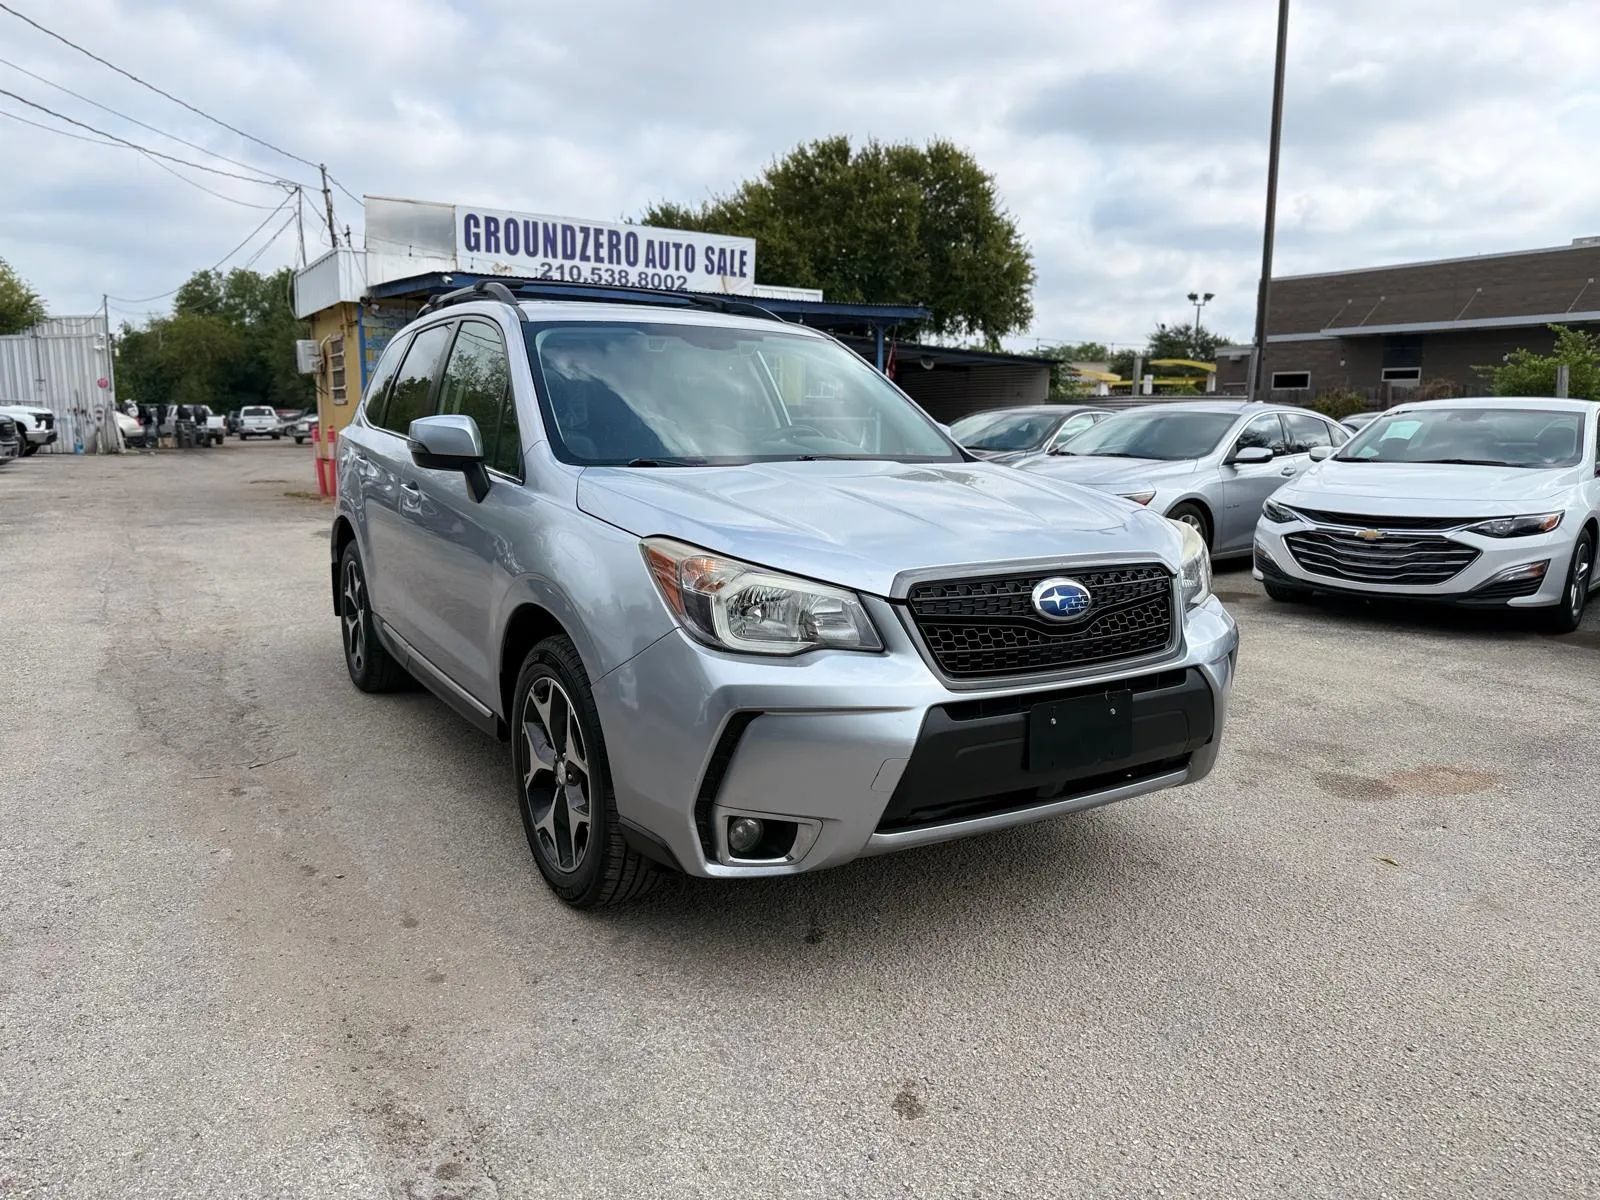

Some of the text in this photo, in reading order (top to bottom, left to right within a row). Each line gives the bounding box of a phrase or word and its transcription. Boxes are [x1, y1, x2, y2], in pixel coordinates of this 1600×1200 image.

[464, 213, 748, 278] GROUNDZERO AUTO SALE
[540, 262, 688, 292] 210.538.8002
